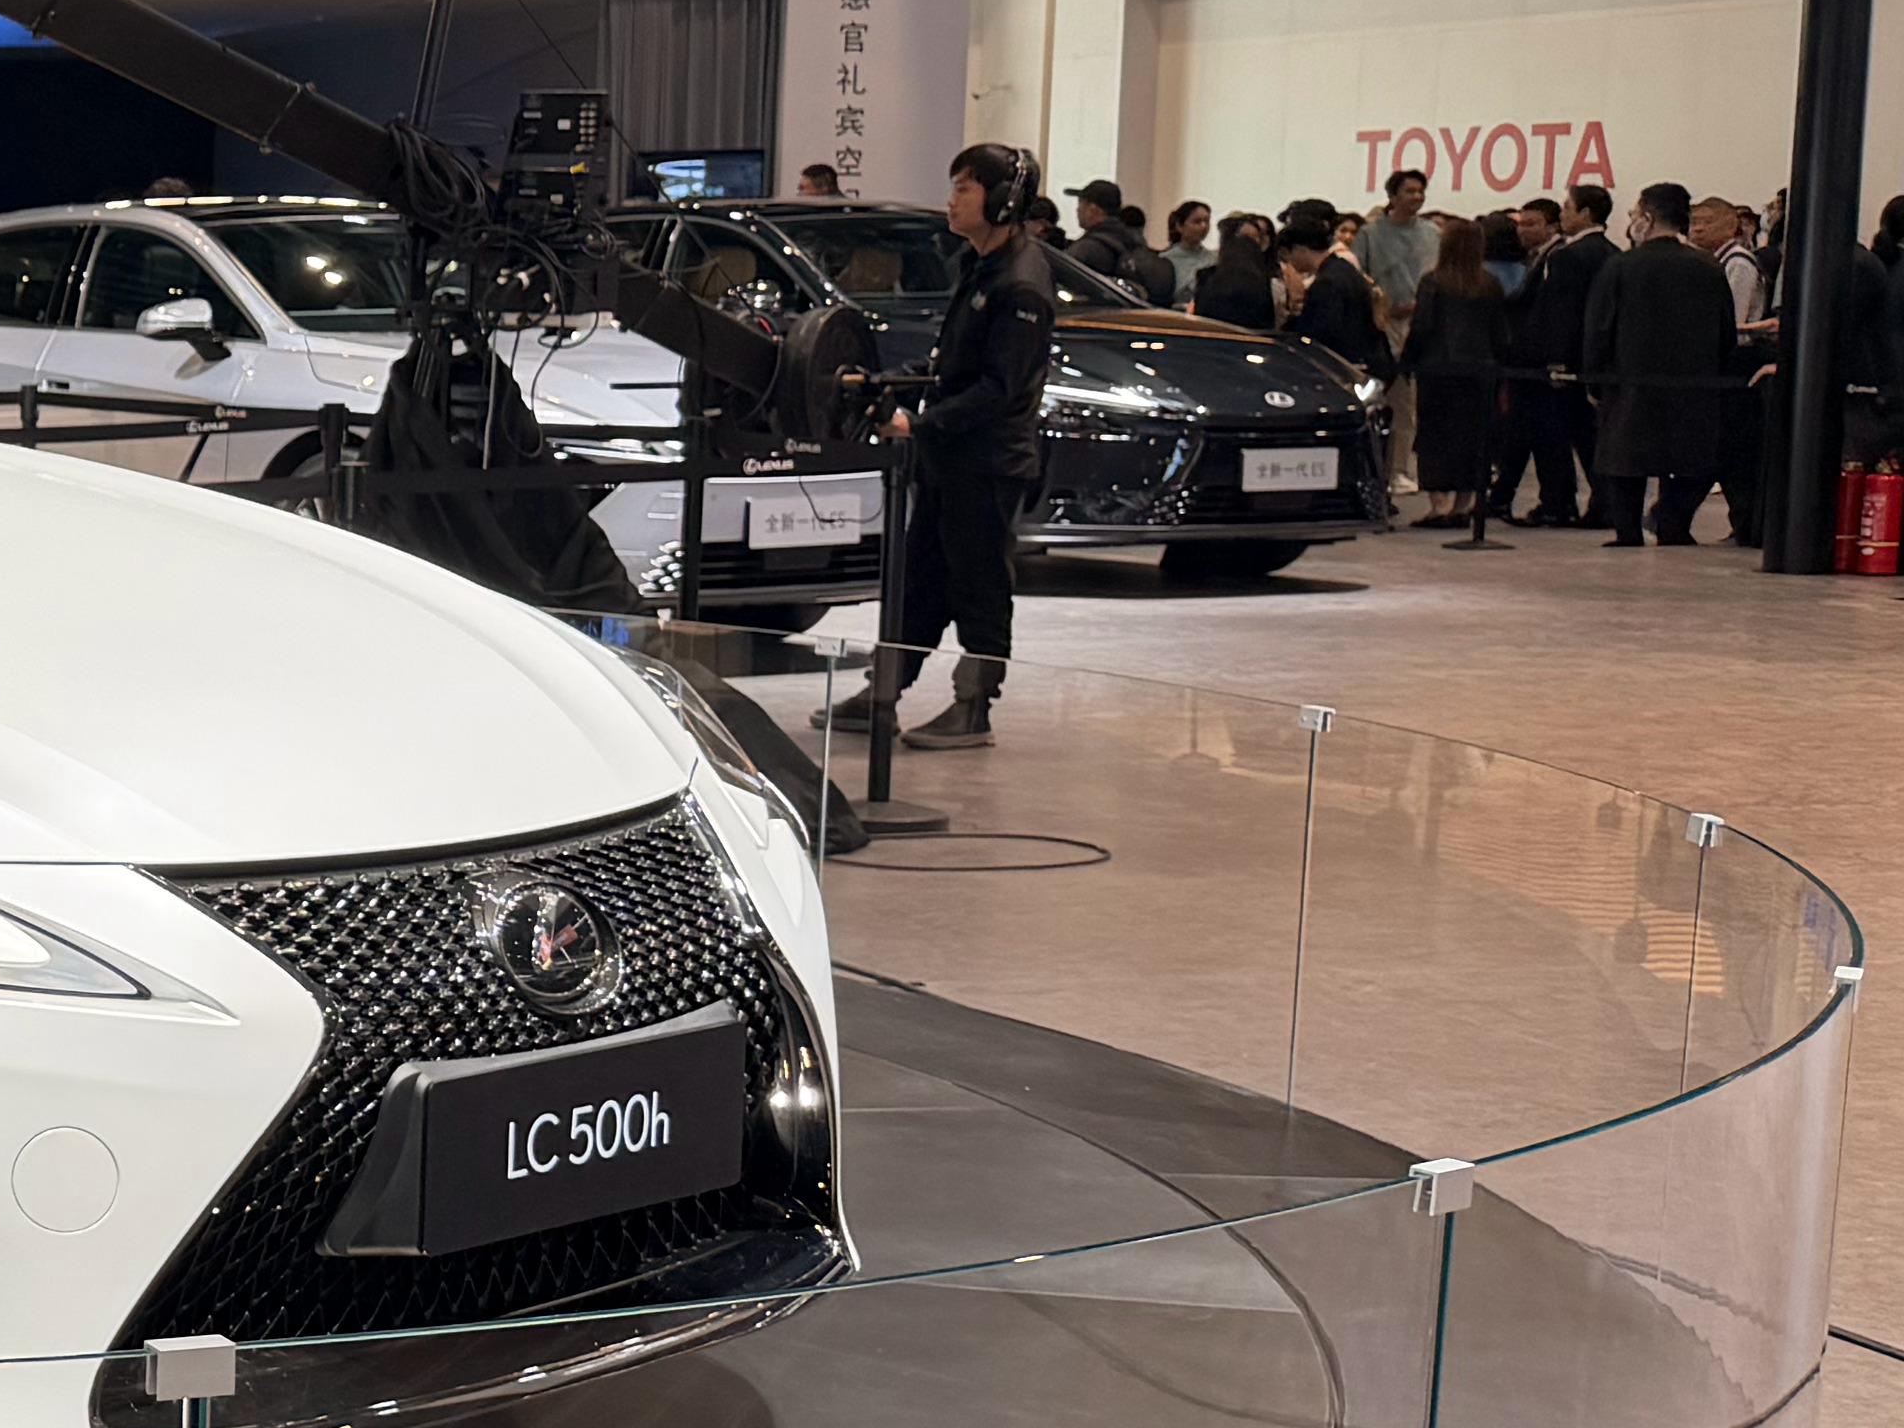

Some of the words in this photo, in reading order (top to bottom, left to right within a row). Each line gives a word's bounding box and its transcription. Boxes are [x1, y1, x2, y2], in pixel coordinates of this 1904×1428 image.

[1356, 121, 1616, 194] TOYOTA
[507, 1112, 561, 1180] LC
[568, 1090, 670, 1166] 500h
